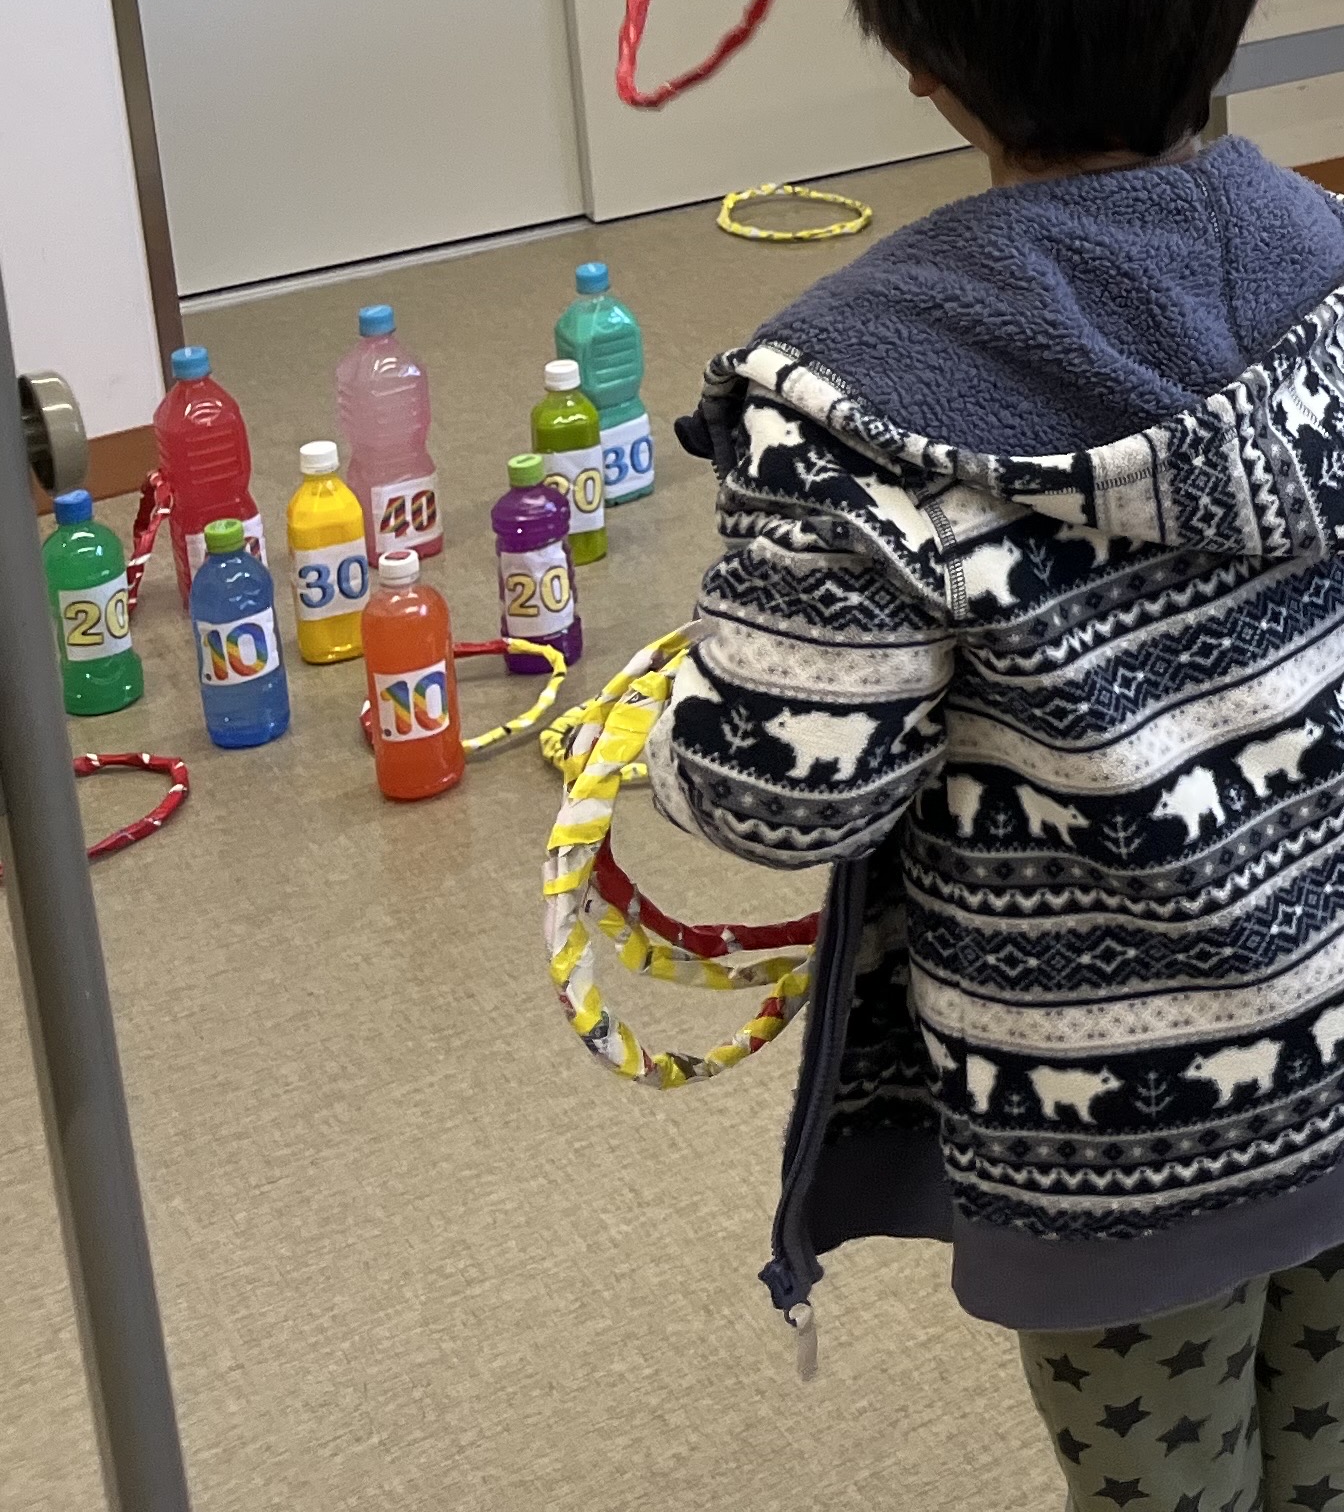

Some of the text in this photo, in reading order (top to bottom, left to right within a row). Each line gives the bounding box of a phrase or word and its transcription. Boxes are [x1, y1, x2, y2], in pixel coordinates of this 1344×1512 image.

[603, 434, 653, 486] 30
[379, 489, 437, 539] 40
[298, 554, 369, 609] 30
[506, 565, 571, 617] 20
[64, 588, 130, 646] 20
[203, 622, 269, 681] 10
[380, 671, 448, 736] 10
